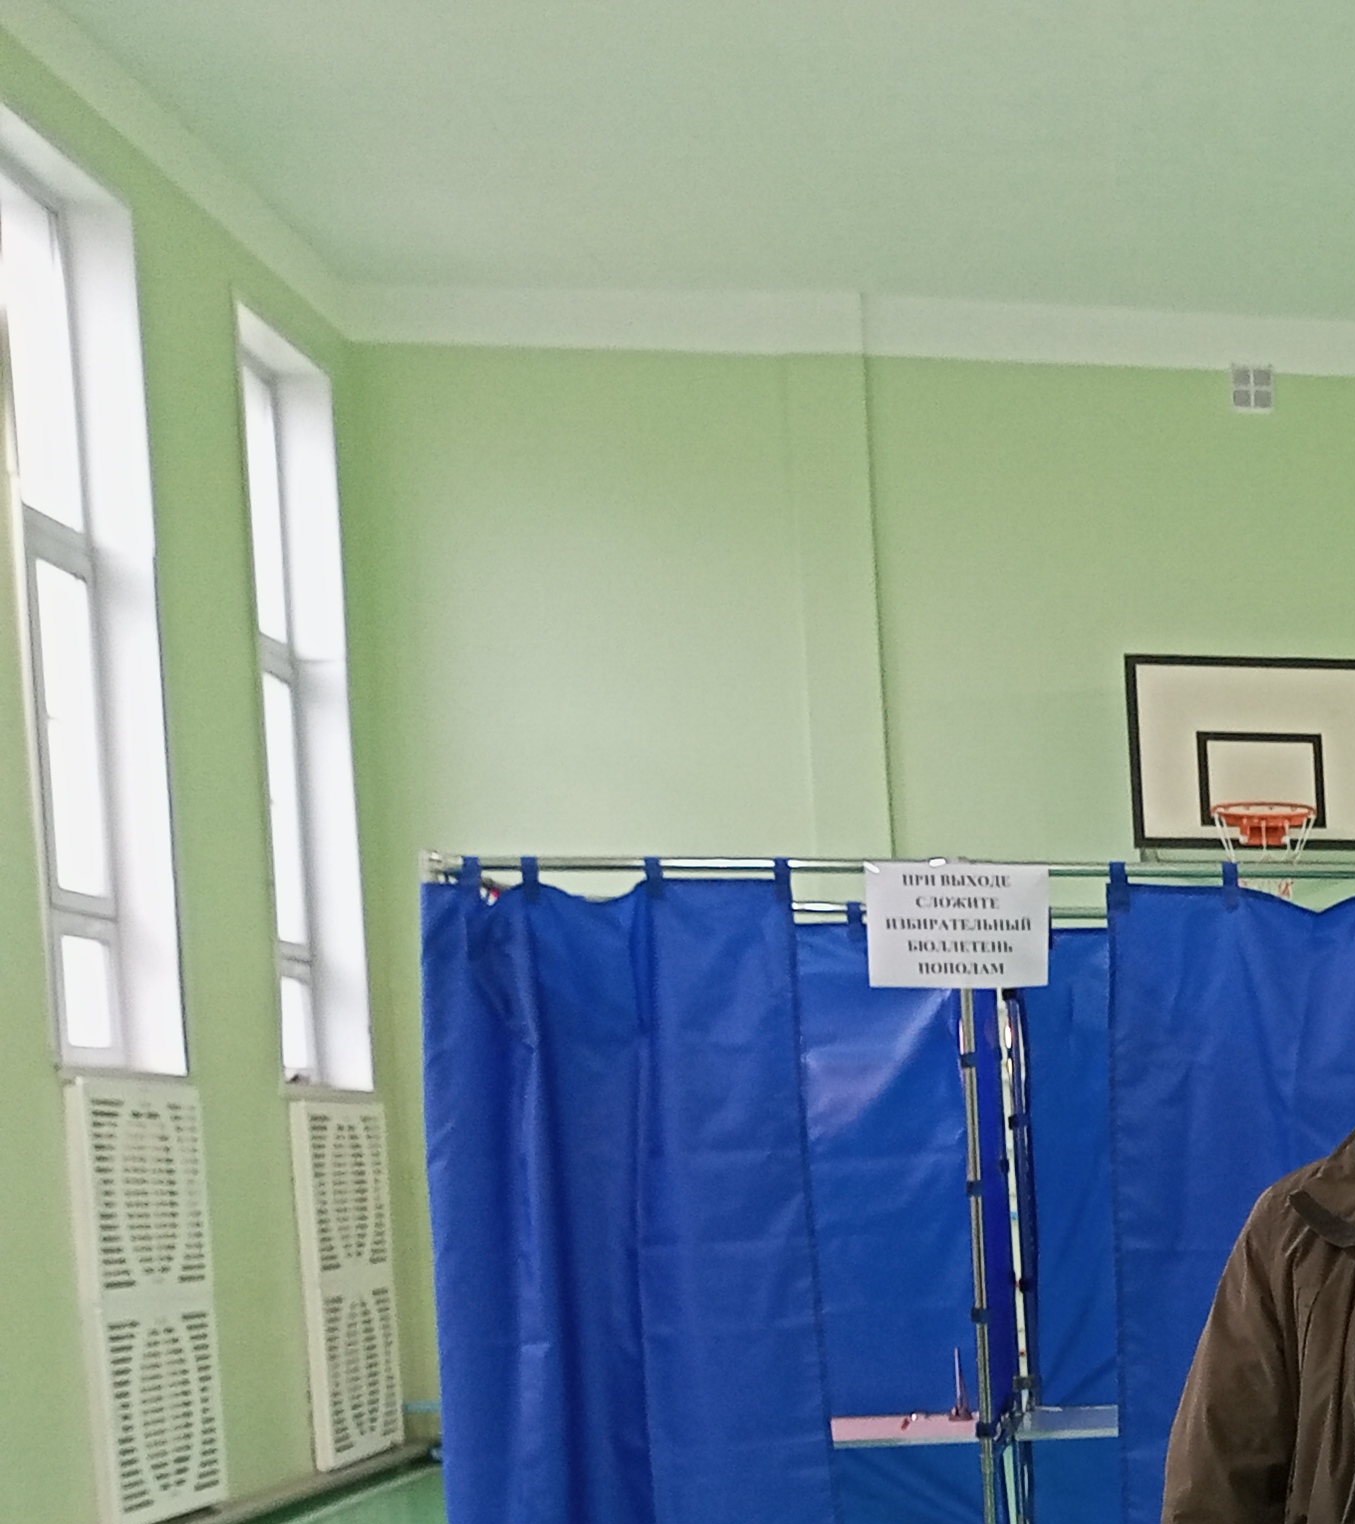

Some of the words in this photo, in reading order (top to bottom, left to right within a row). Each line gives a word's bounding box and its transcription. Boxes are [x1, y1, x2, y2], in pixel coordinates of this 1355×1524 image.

[902, 874, 936, 887] ПРИ
[941, 874, 1010, 888] ВЫХОДЕ
[915, 896, 1000, 910] СЛОЖИТЕ
[886, 916, 1031, 931] ИЗБИРАТЕЛЬНЫЙ
[908, 940, 1013, 953] БЮЛЛЕТЕНЬ
[918, 962, 1004, 975] ПОПОЛАМ
